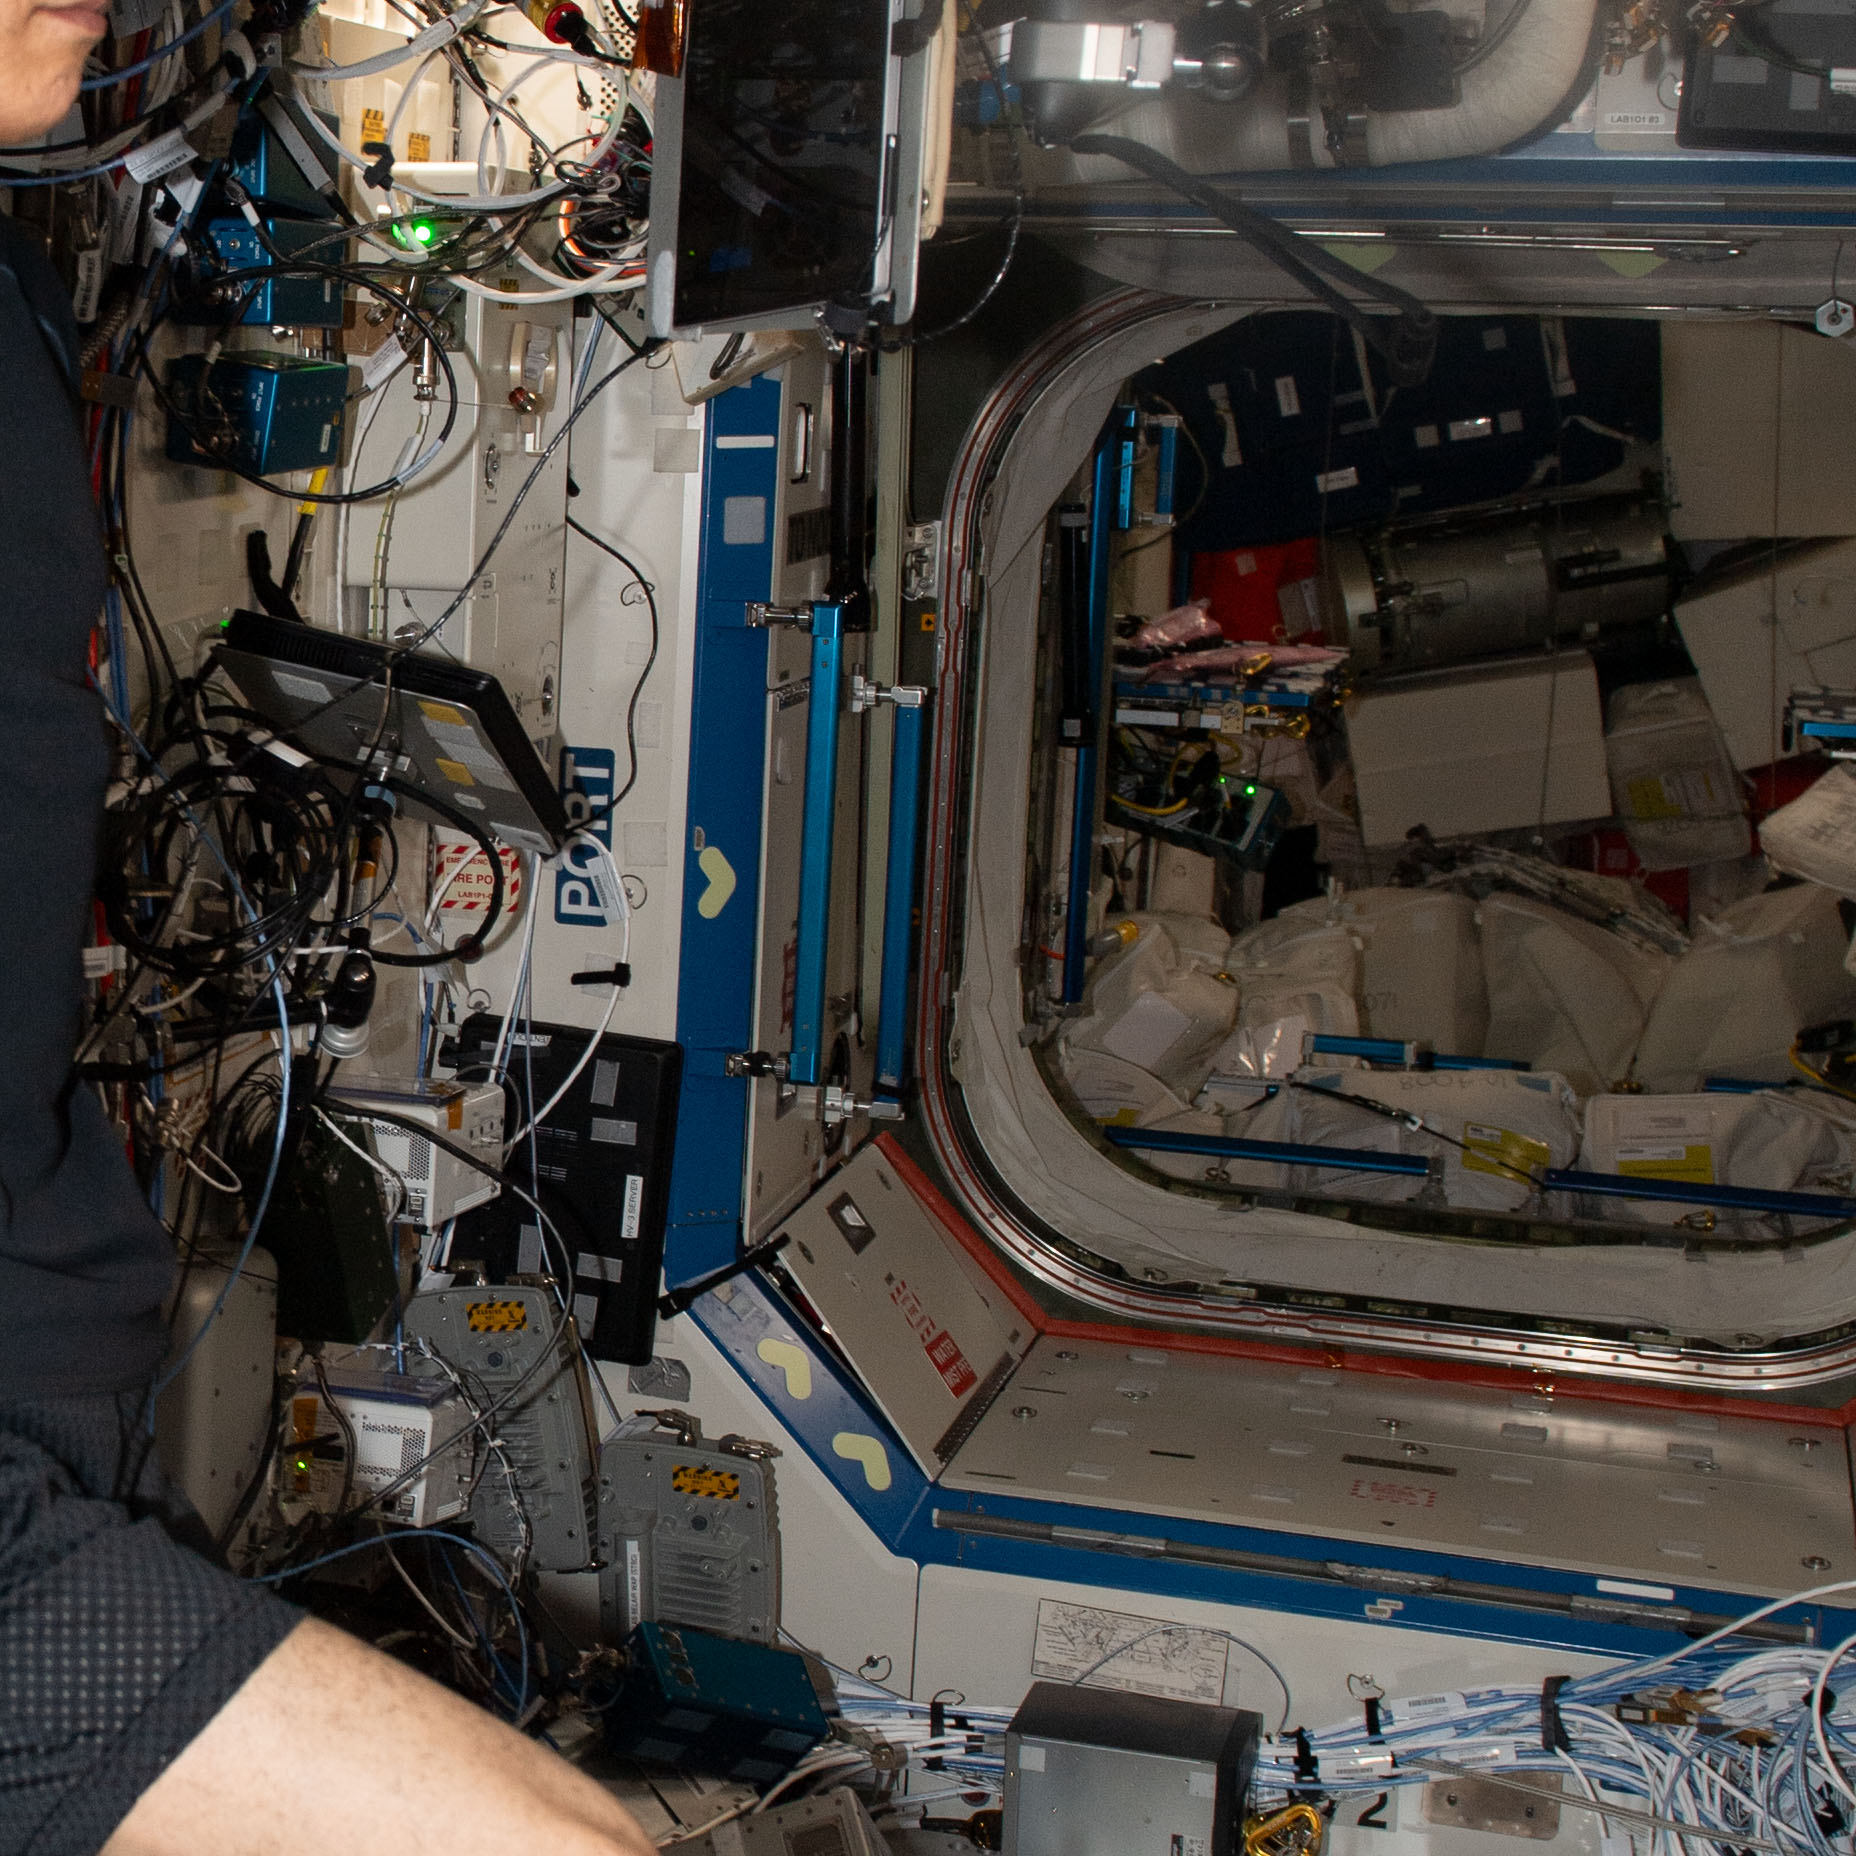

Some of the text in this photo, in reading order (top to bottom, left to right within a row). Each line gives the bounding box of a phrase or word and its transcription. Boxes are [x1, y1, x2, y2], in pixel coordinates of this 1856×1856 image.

[557, 749, 612, 918] PORT
[476, 873, 510, 886] POT
[626, 1177, 639, 1209] SERVER
[1356, 1791, 1389, 1830] 2
